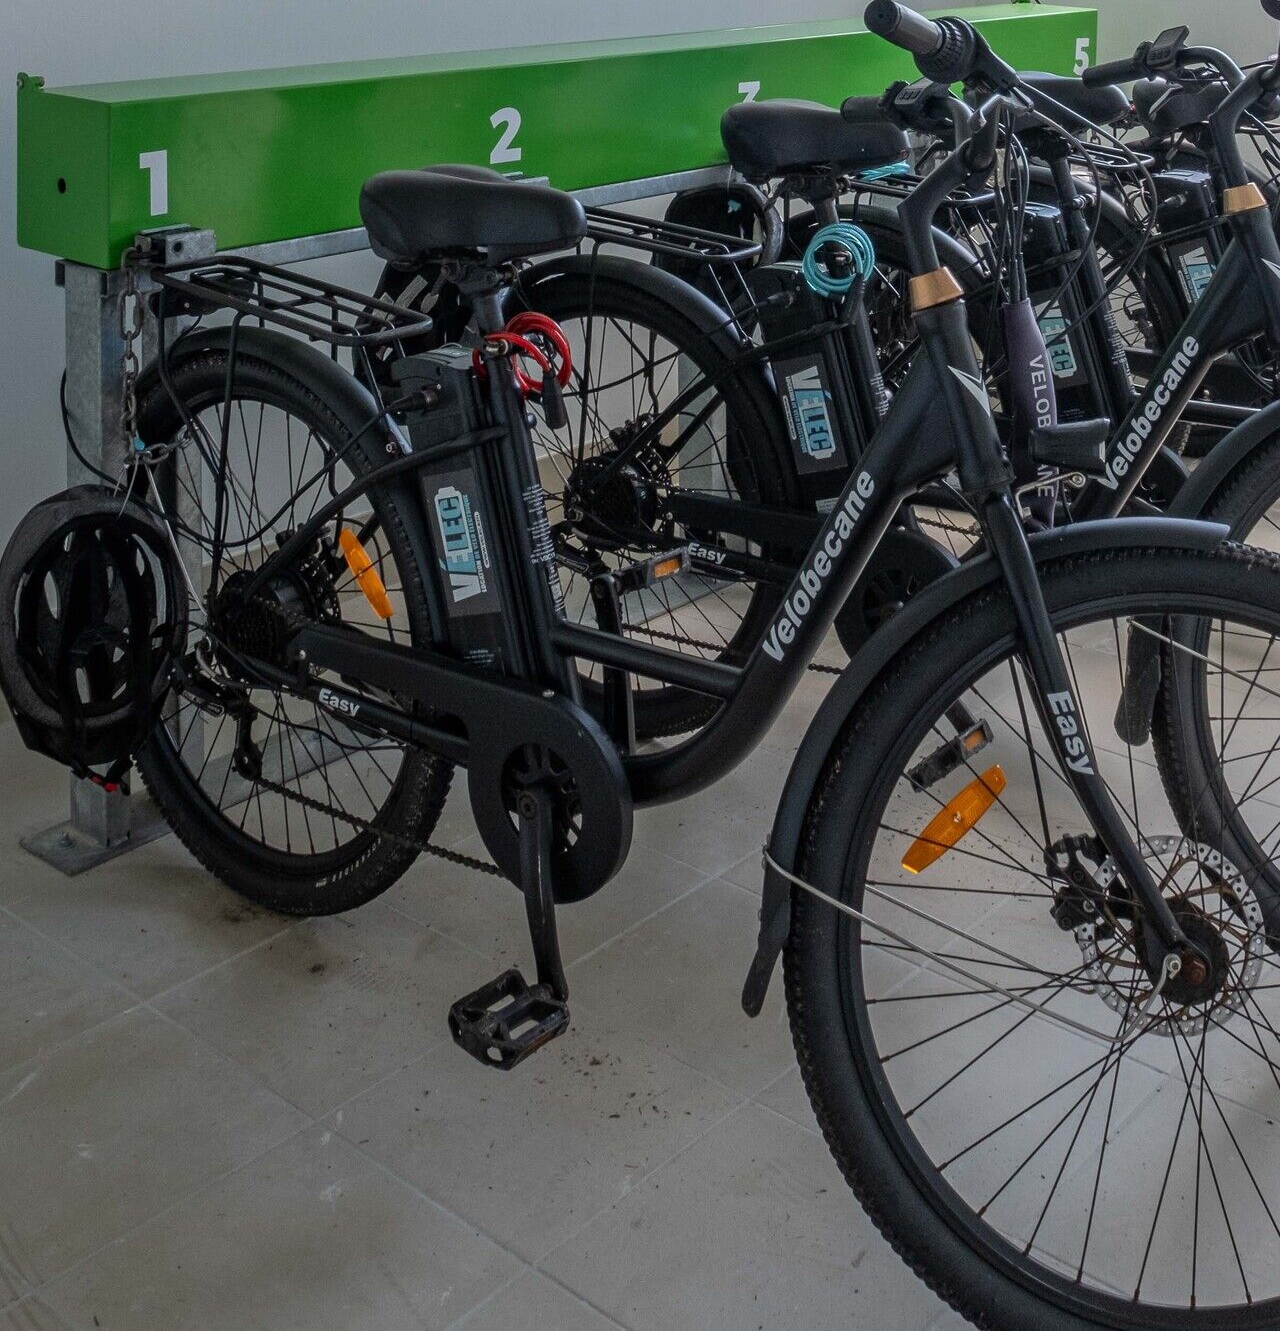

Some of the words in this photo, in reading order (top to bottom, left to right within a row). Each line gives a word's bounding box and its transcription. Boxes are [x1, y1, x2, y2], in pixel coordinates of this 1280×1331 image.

[1073, 37, 1090, 76] 5
[489, 107, 522, 165] 2
[139, 149, 169, 216] 1
[790, 365, 833, 452] VÉLEC
[1097, 335, 1200, 490] Velobecane
[438, 495, 482, 603] VÉLEC
[687, 541, 727, 565] Easy
[761, 471, 875, 662] Velobecane
[318, 687, 361, 717] Easy
[1046, 691, 1095, 776] Easy
